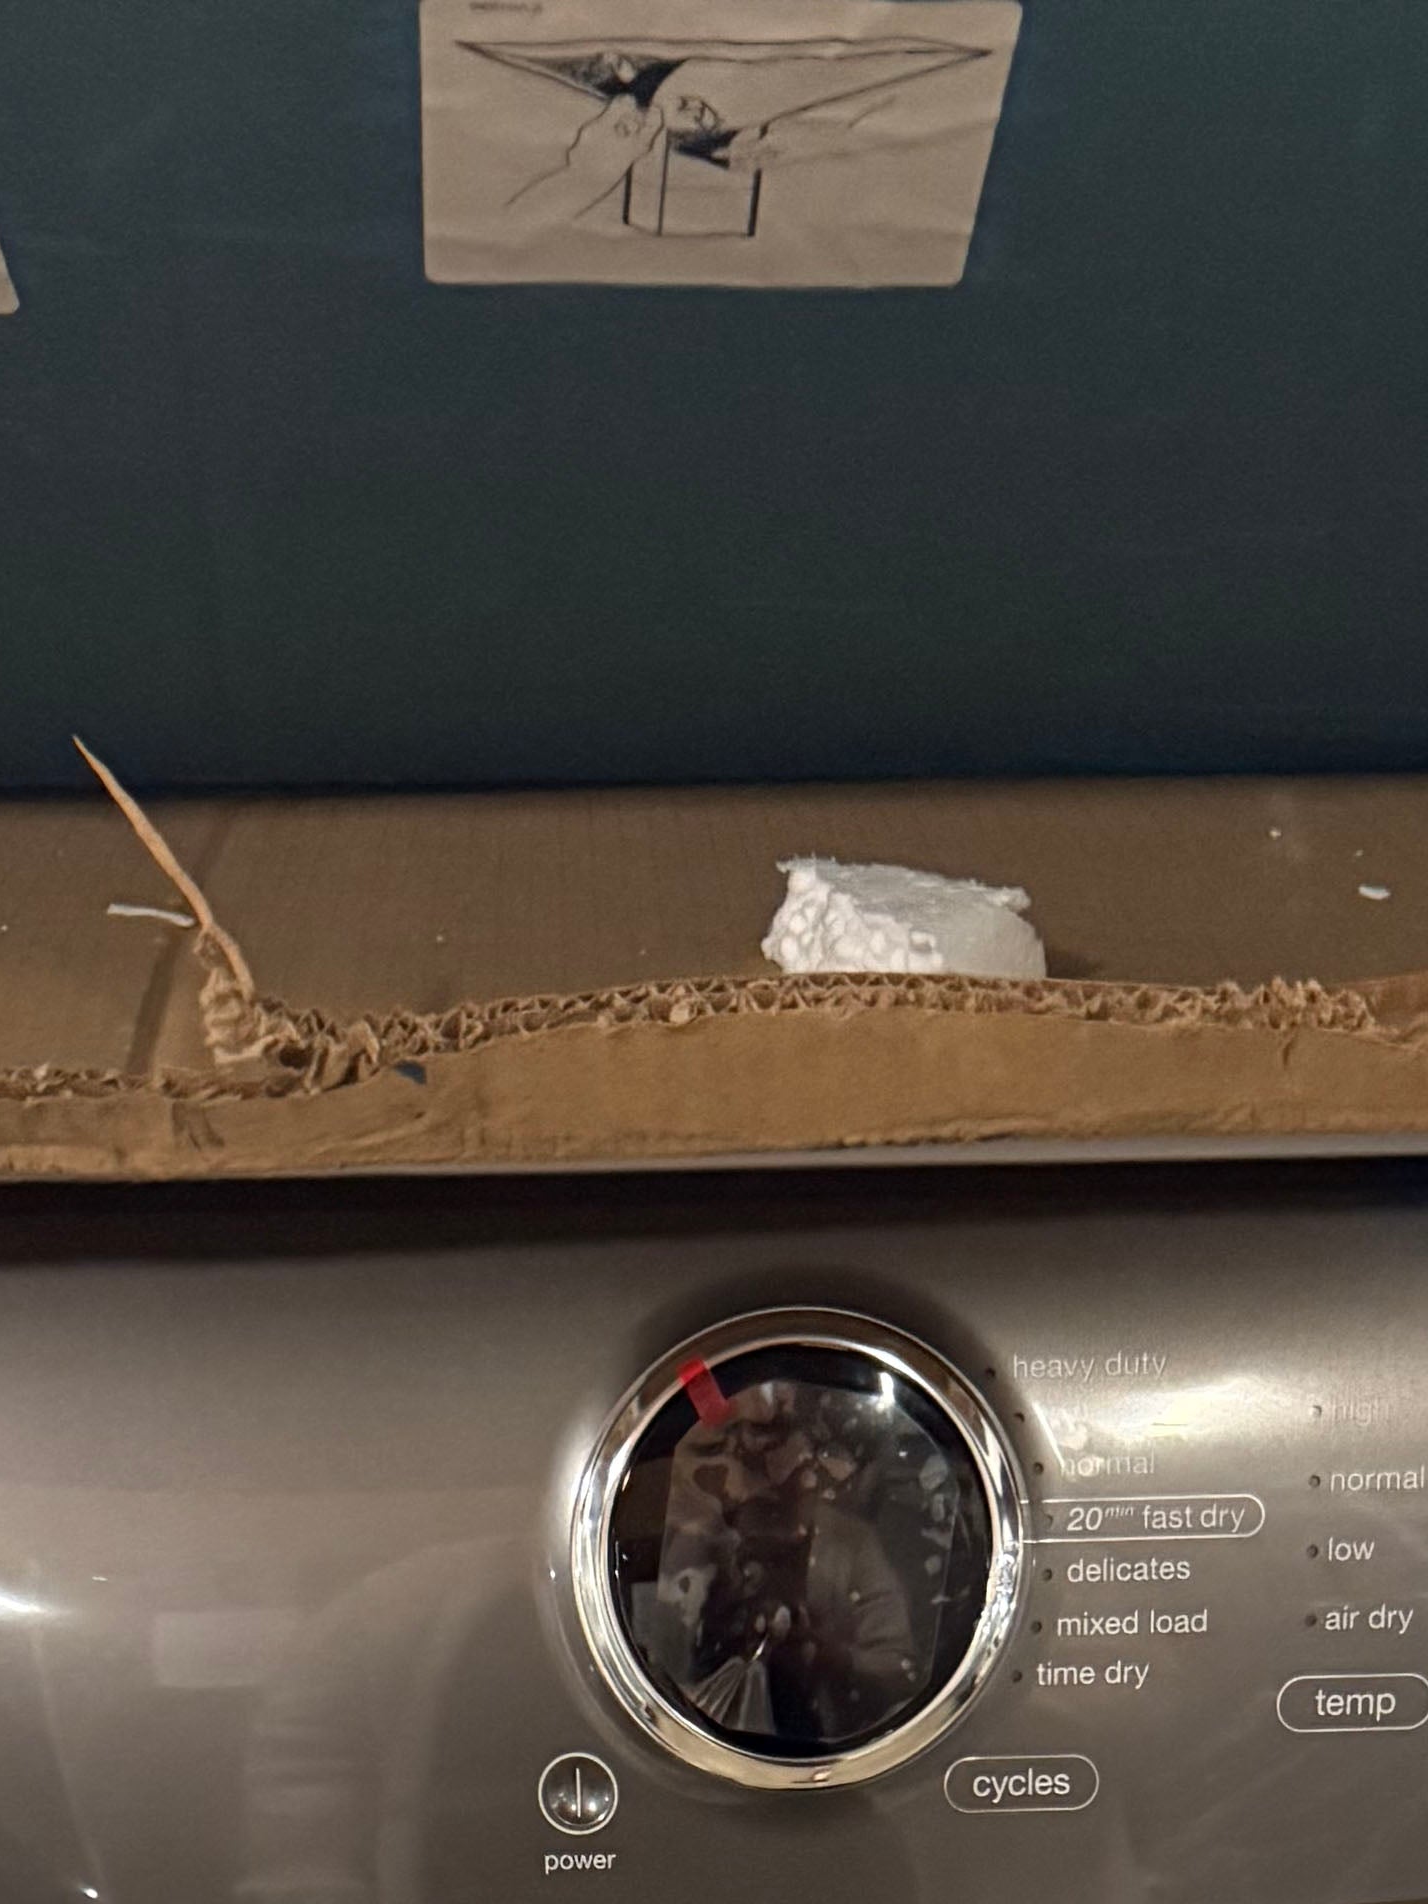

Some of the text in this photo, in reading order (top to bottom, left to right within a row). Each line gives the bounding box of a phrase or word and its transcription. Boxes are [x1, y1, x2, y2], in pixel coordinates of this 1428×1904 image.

[1013, 1350, 1167, 1382] heavy duty
[1060, 1451, 1155, 1476] normal
[1329, 1465, 1425, 1492] normal
[1142, 1503, 1193, 1529] fast
[1199, 1503, 1245, 1534] dry
[1328, 1536, 1375, 1562] low
[1066, 1556, 1191, 1583] delicates
[1056, 1608, 1208, 1637] mixed load
[1324, 1603, 1414, 1635] air dry
[1036, 1659, 1150, 1690] time dry
[1315, 1688, 1397, 1722] temp
[972, 1768, 1071, 1802] cycles
[544, 1848, 616, 1875] power
